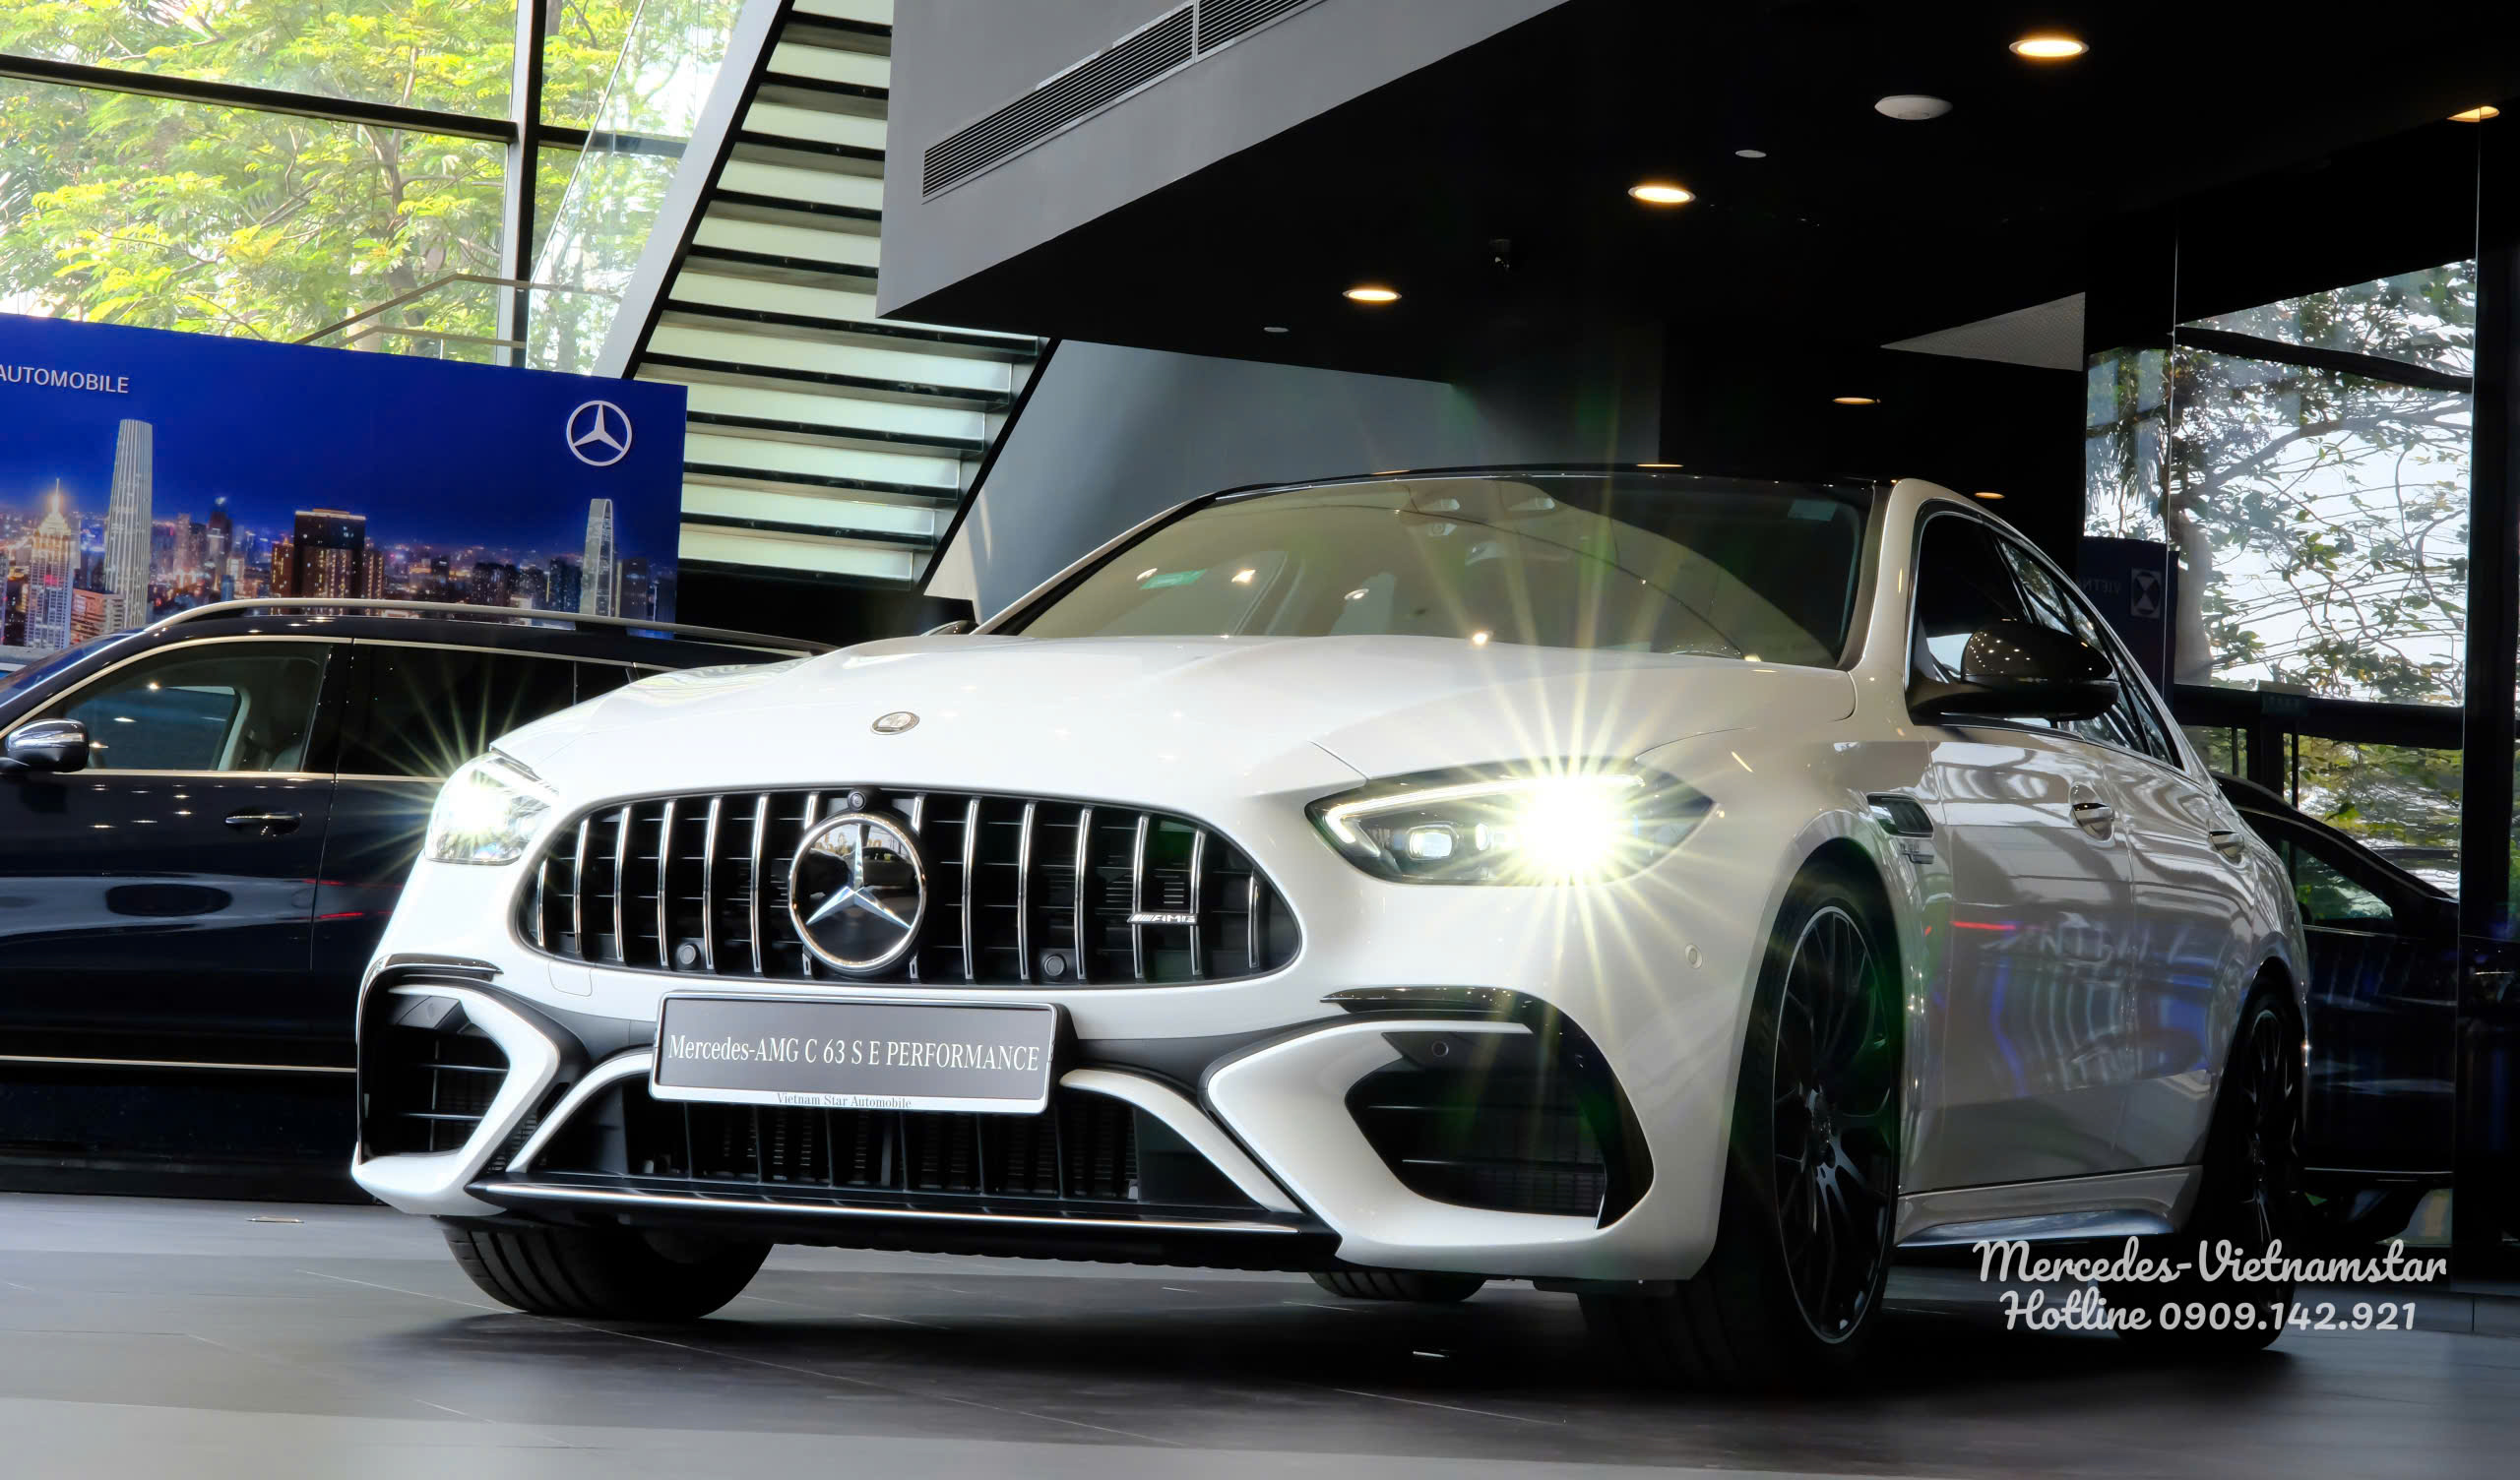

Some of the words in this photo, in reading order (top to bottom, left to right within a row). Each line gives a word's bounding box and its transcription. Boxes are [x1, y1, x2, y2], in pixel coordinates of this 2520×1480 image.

[668, 1034, 799, 1063] Mercedes-AMG
[804, 1038, 818, 1064] C
[823, 1038, 846, 1064] 63
[850, 1040, 863, 1065] S
[868, 1040, 881, 1066] E
[886, 1041, 1040, 1072] PERFORMANCE
[777, 1092, 821, 1106] Vietnam
[824, 1095, 849, 1107] Star
[850, 1096, 913, 1110] Automobile
